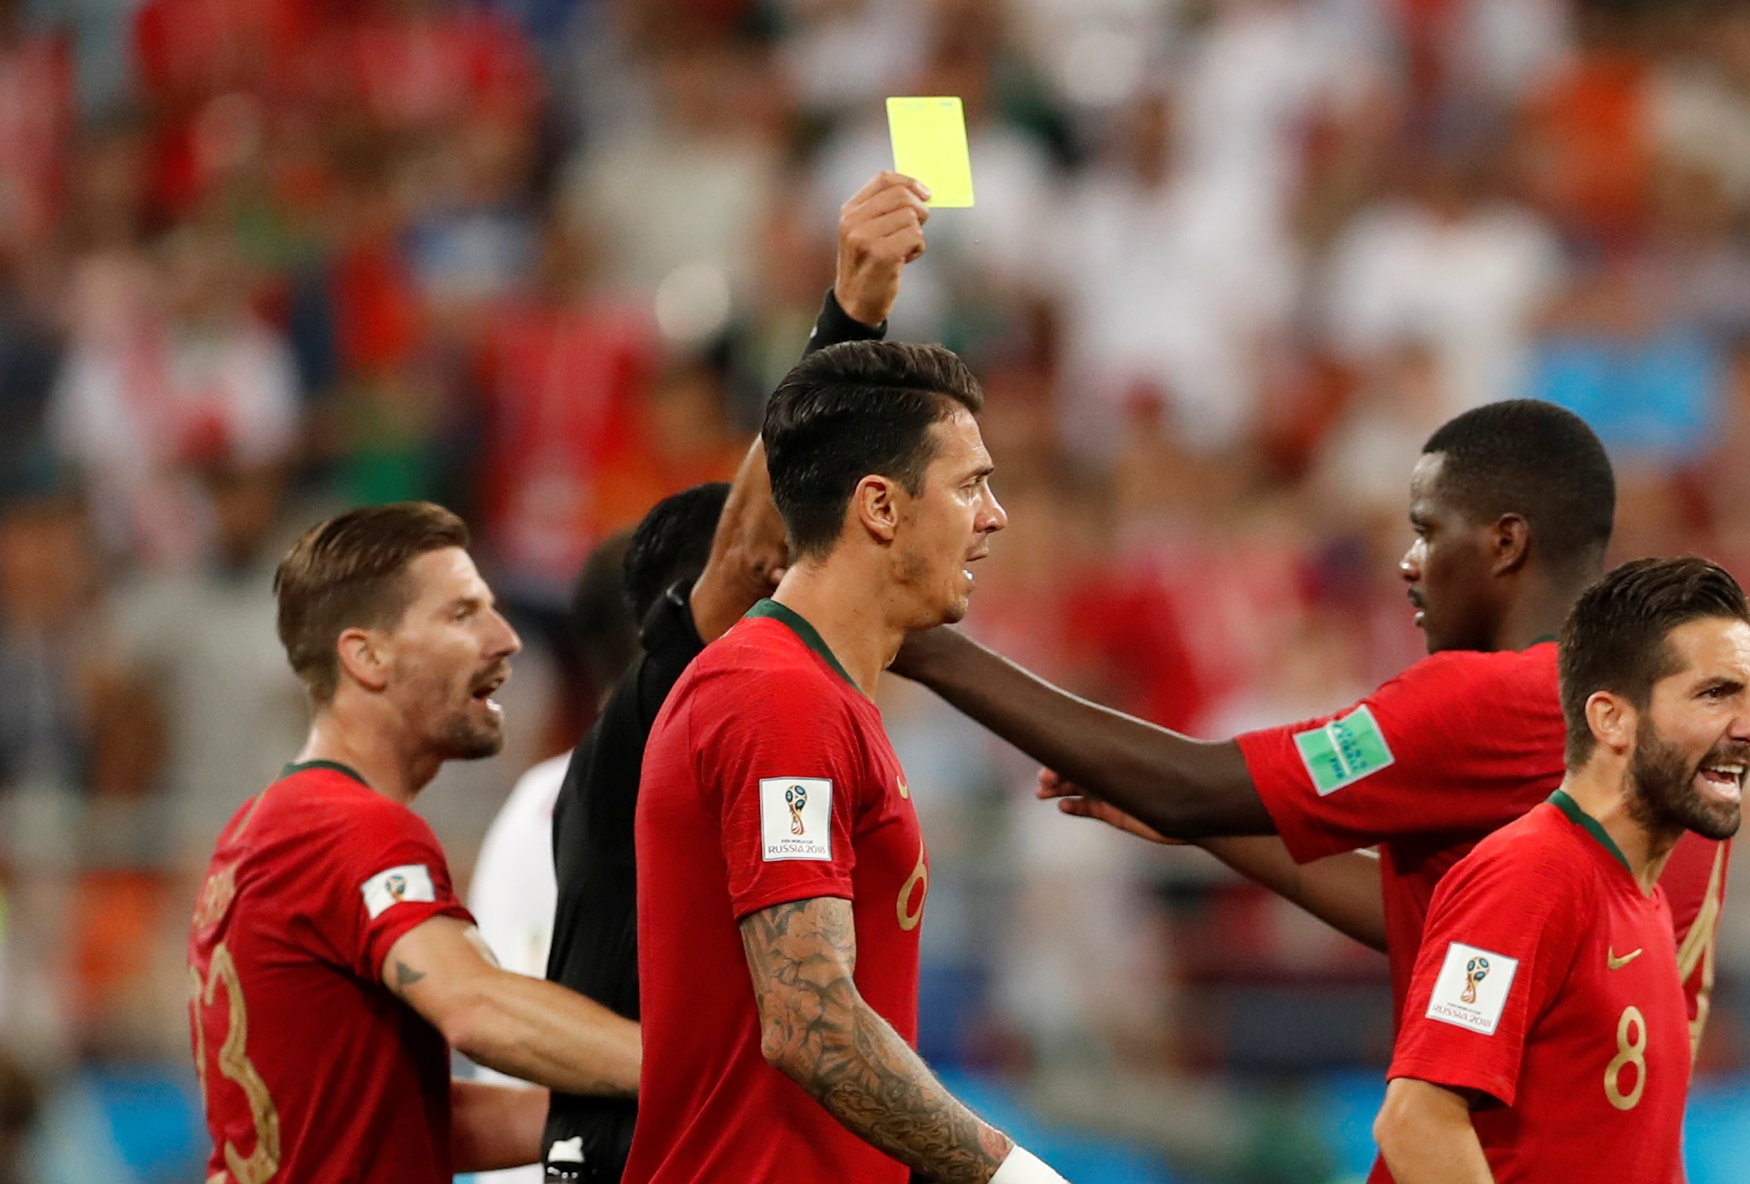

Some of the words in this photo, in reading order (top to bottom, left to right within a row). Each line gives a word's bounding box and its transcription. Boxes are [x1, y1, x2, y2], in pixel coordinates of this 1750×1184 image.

[767, 844, 804, 855] RUSSIA
[895, 836, 929, 932] 6
[1603, 1005, 1647, 1111] 8
